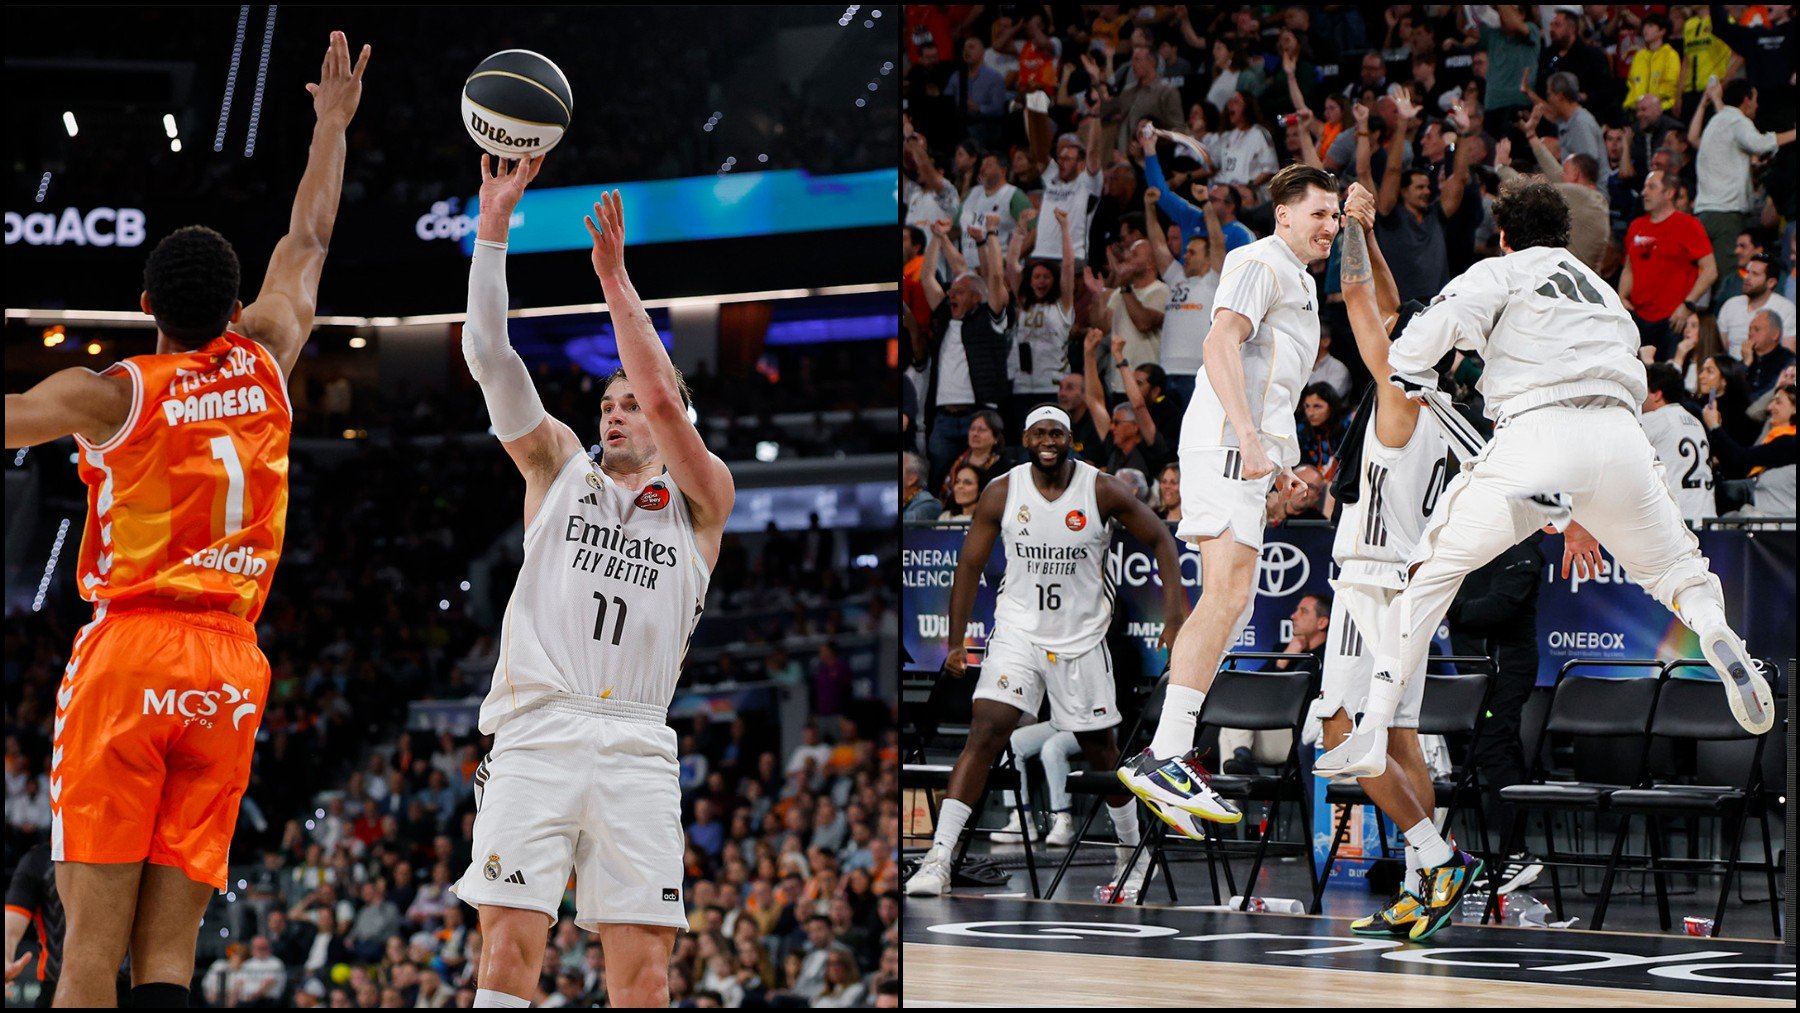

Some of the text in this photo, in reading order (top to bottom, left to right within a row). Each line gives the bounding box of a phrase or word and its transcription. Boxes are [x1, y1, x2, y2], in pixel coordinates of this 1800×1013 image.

[471, 111, 540, 147] Wilson
[162, 385, 268, 427] PAMESA
[210, 435, 245, 538] 1
[566, 515, 677, 567] Emirates
[1015, 542, 1088, 560] Emirates
[572, 548, 659, 590] FLY BETTER
[1027, 560, 1077, 575] FLY BETTER
[1036, 583, 1061, 611] 16
[592, 591, 628, 646] 11
[1548, 631, 1625, 649] ONEBOX
[664, 892, 677, 900] acb
